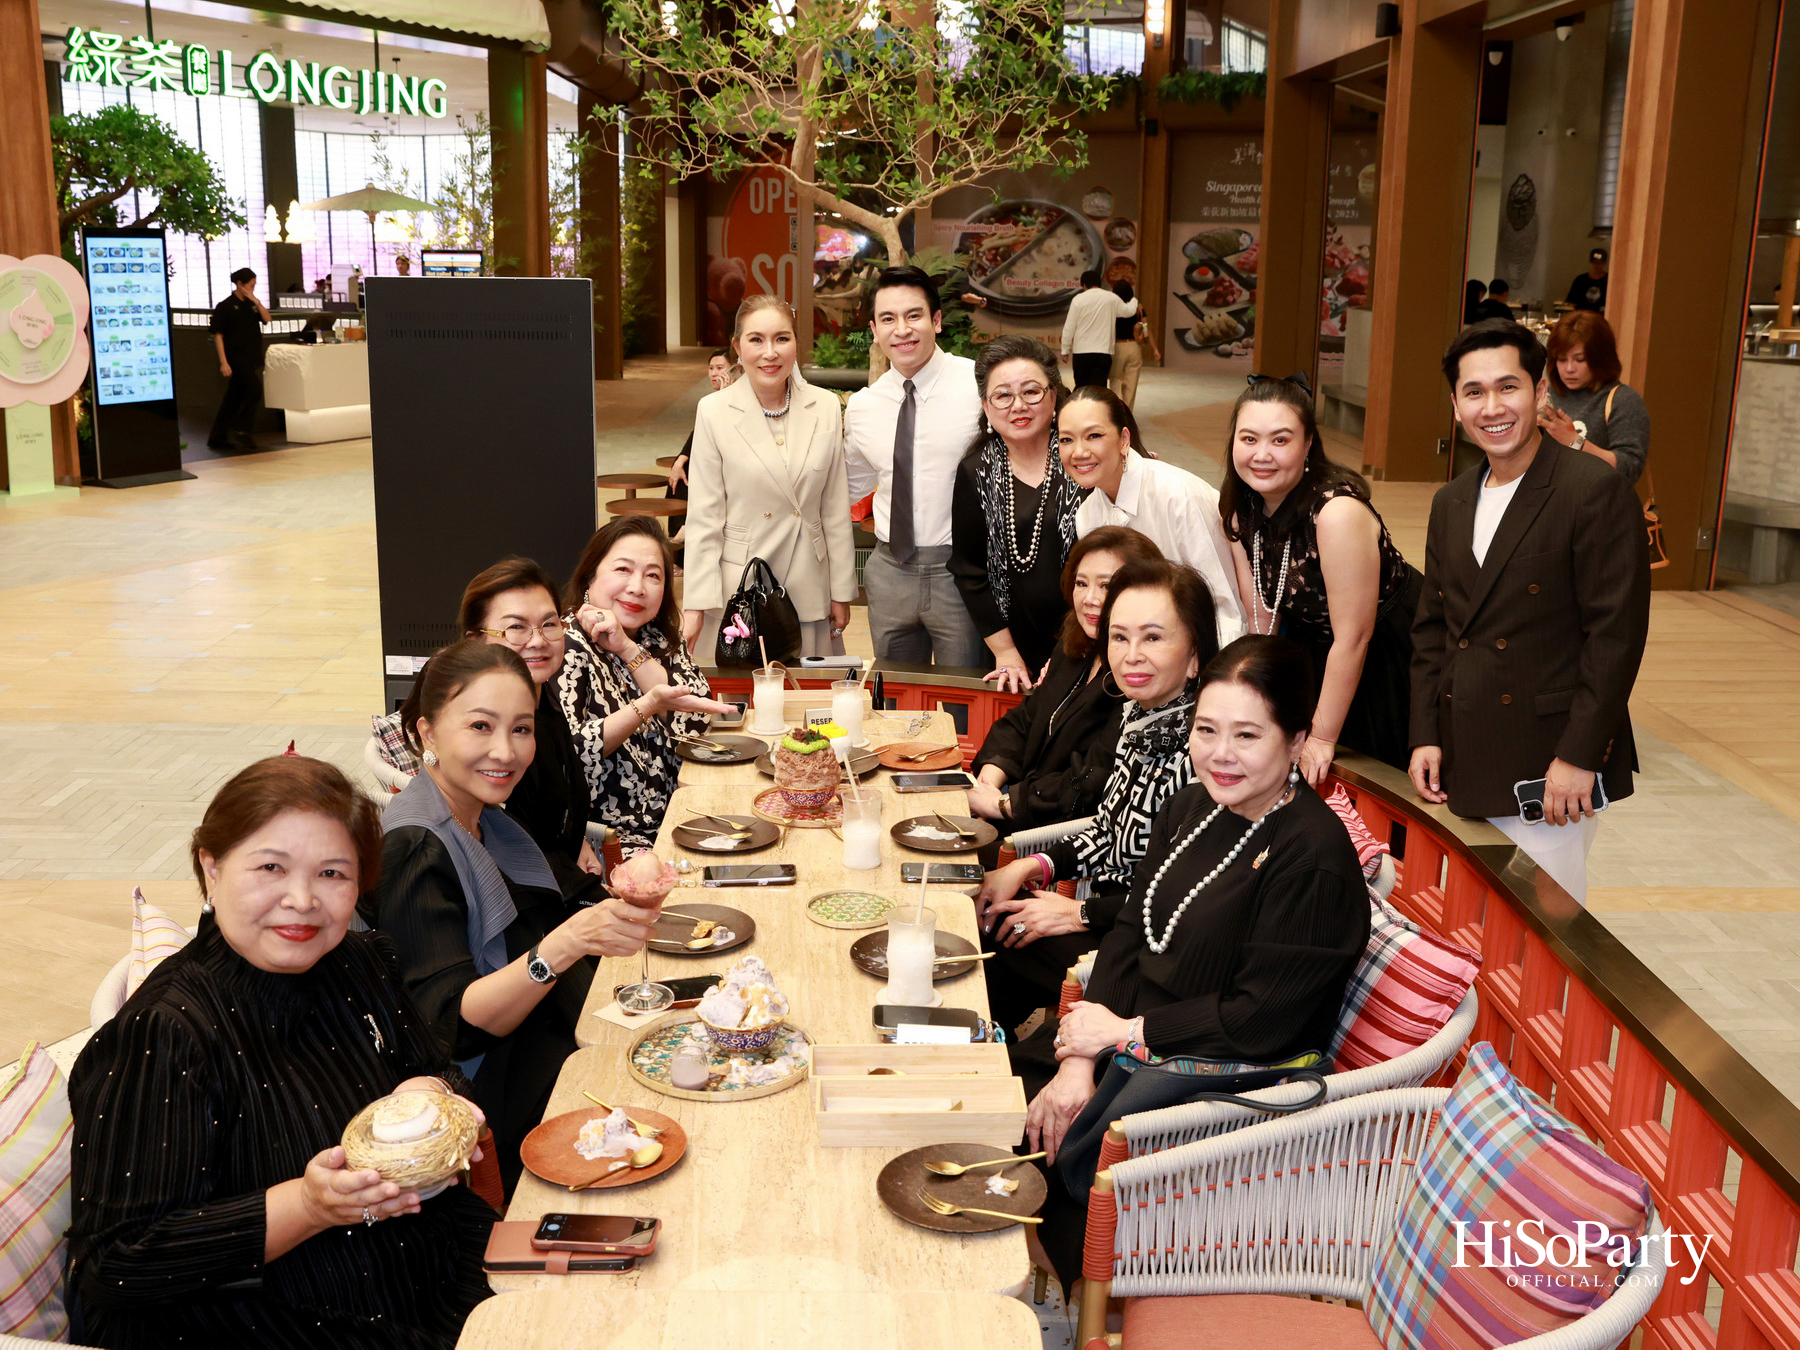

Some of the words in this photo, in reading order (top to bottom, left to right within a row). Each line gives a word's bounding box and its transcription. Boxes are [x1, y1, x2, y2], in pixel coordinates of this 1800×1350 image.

[219, 49, 448, 118] LONGJING
[749, 177, 797, 214] OPE
[954, 224, 993, 233] Nourishing
[751, 253, 798, 311] SO
[1006, 279, 1032, 288] Beauty
[1033, 279, 1065, 288] Collagen
[1066, 280, 1081, 288] Bro
